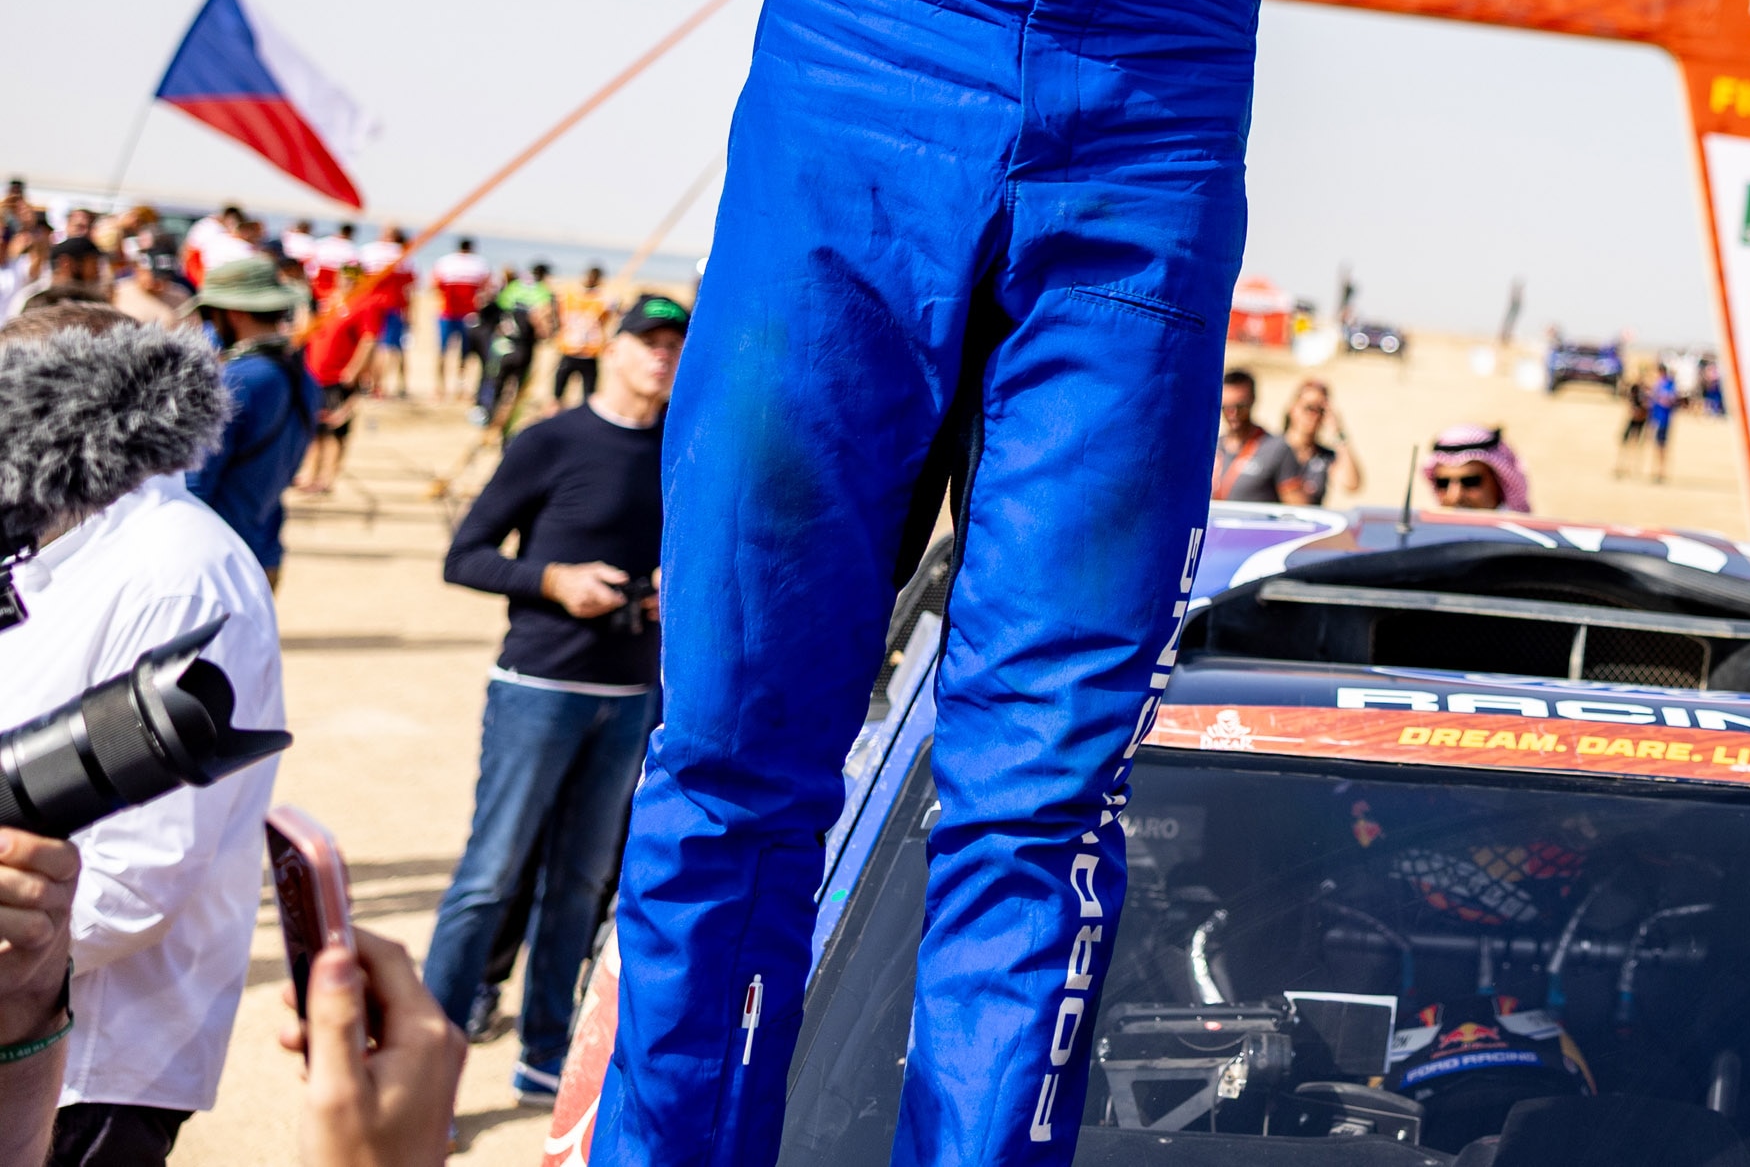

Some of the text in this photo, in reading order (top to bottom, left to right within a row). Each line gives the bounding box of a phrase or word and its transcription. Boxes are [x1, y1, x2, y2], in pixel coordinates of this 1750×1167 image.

[1398, 726, 1567, 753] DREAM.
[1577, 735, 1703, 763] DARE.
[1030, 852, 1104, 1143] FORD
